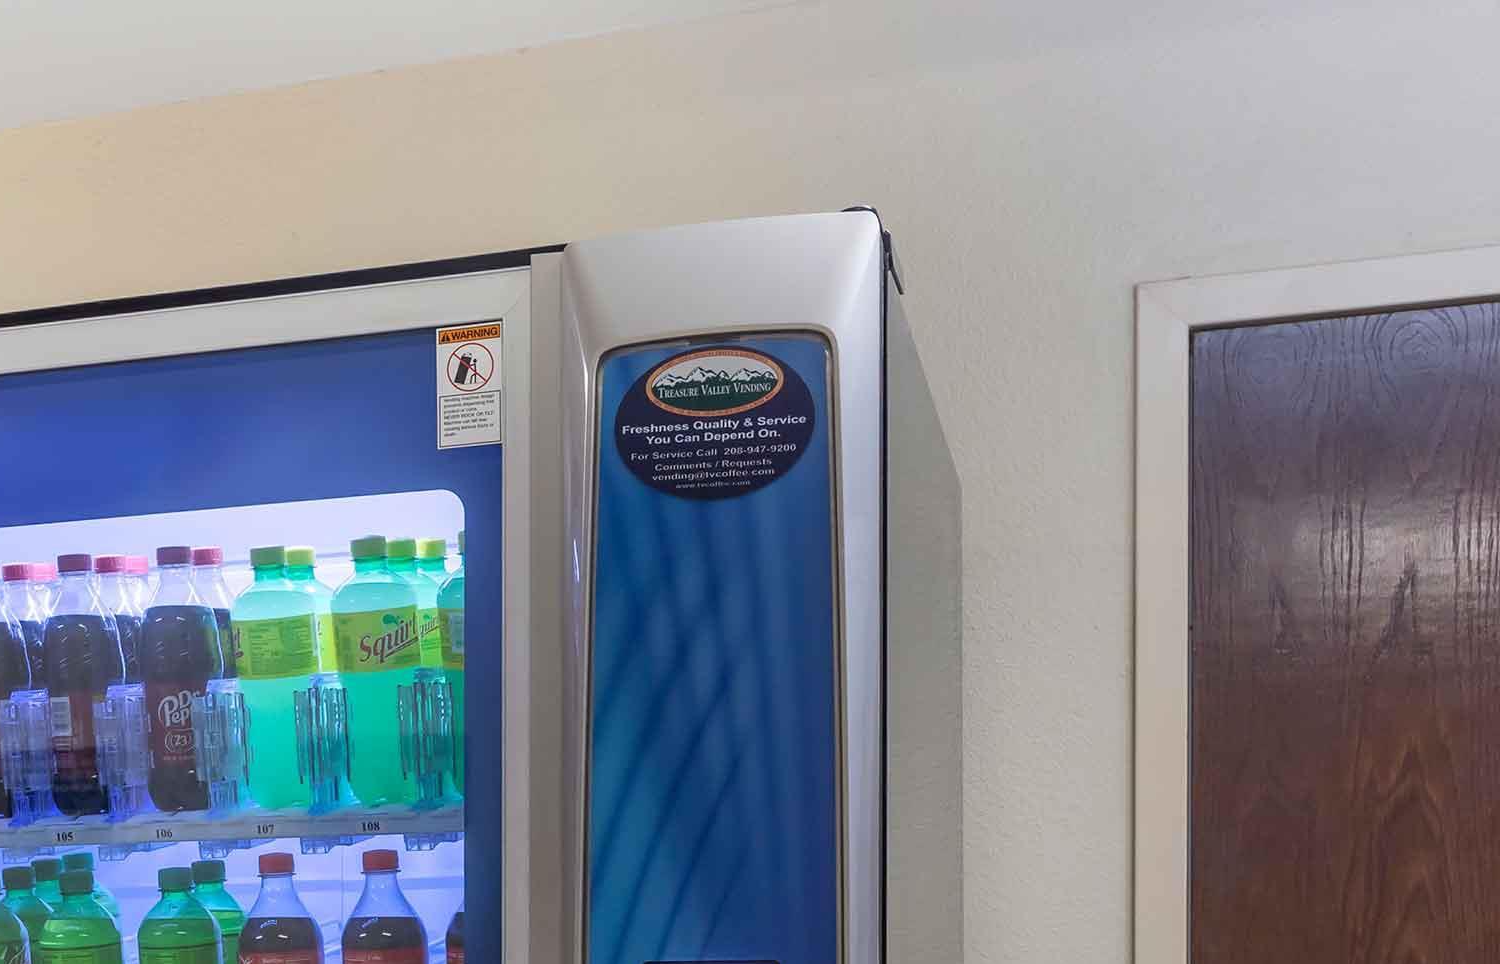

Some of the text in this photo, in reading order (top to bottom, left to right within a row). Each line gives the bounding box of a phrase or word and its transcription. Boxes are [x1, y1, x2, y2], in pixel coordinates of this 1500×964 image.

[451, 326, 498, 341] WARNING
[658, 381, 772, 399] TREASURE VALLEY VENDING
[622, 415, 807, 435] Freshness Quality & Service
[646, 428, 781, 445] You Can Depend On.
[631, 452, 649, 461] For
[652, 450, 693, 460] Service
[696, 449, 718, 457] Call
[655, 461, 712, 472] Comments
[721, 458, 773, 469] Requests
[257, 824, 275, 834] 107
[361, 821, 380, 832] 108
[56, 832, 73, 842] 105
[155, 829, 173, 839] 106
